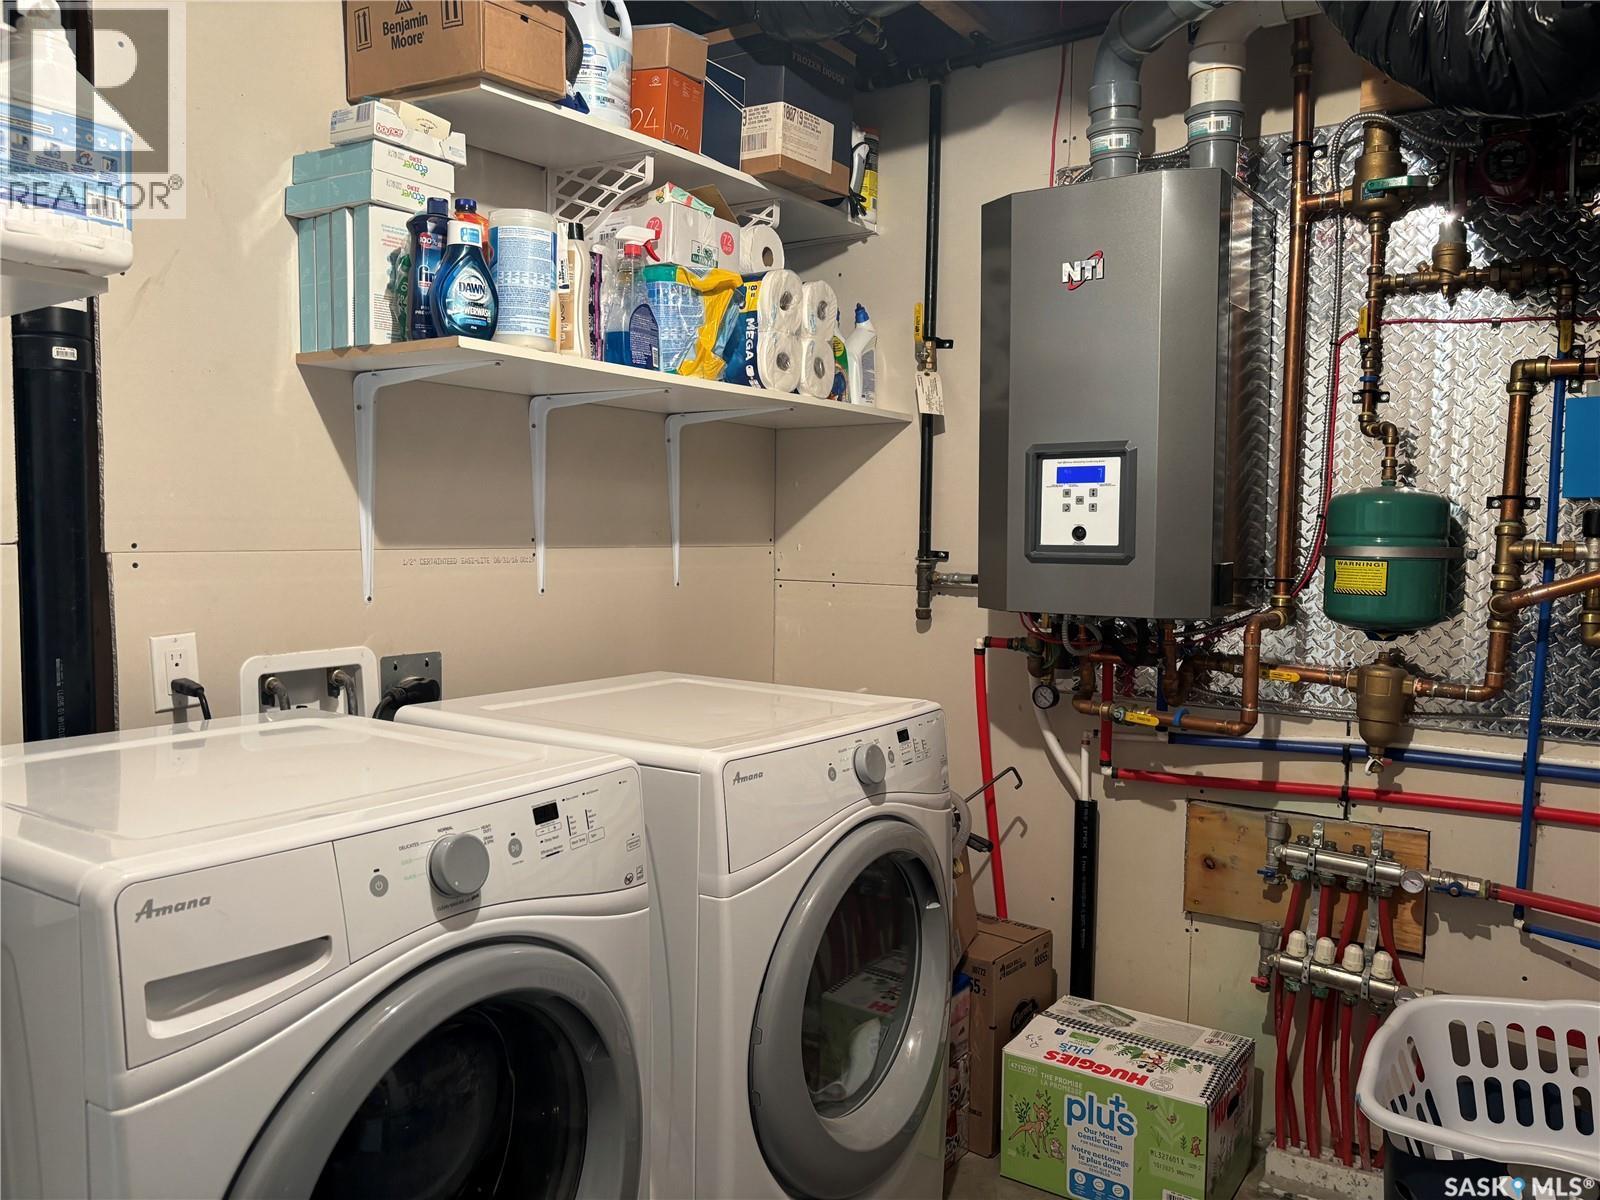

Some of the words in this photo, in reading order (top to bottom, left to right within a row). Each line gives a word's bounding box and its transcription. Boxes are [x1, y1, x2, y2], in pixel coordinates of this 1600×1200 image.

[383, 12, 428, 36] Benjamin
[631, 107, 660, 134] 24
[376, 122, 404, 137] bounce
[402, 160, 429, 174] ecover
[408, 155, 423, 164] ZERO
[400, 189, 426, 203] ecover
[406, 184, 420, 192] ZERO
[722, 234, 732, 246] 72
[1062, 257, 1105, 283] NTI
[458, 281, 486, 295] DAWN
[745, 318, 755, 361] MEGA
[733, 771, 764, 785] Amana
[398, 842, 420, 851] DELICATES
[134, 896, 212, 923] Amana
[1043, 1050, 1149, 1086] HUGGIES
[1041, 1072, 1053, 1082] THE
[1054, 1077, 1083, 1089] PROMISE
[1077, 1131, 1102, 1144] Gentle
[1102, 1140, 1123, 1151] Clean
[1083, 1127, 1098, 1136] Our
[1098, 1131, 1118, 1142] Most
[1071, 1144, 1092, 1157] Notre
[1092, 1150, 1129, 1168] nettoyage
[1078, 1153, 1085, 1161] le
[1086, 1155, 1102, 1167] plus
[1102, 1161, 1122, 1173] doux
